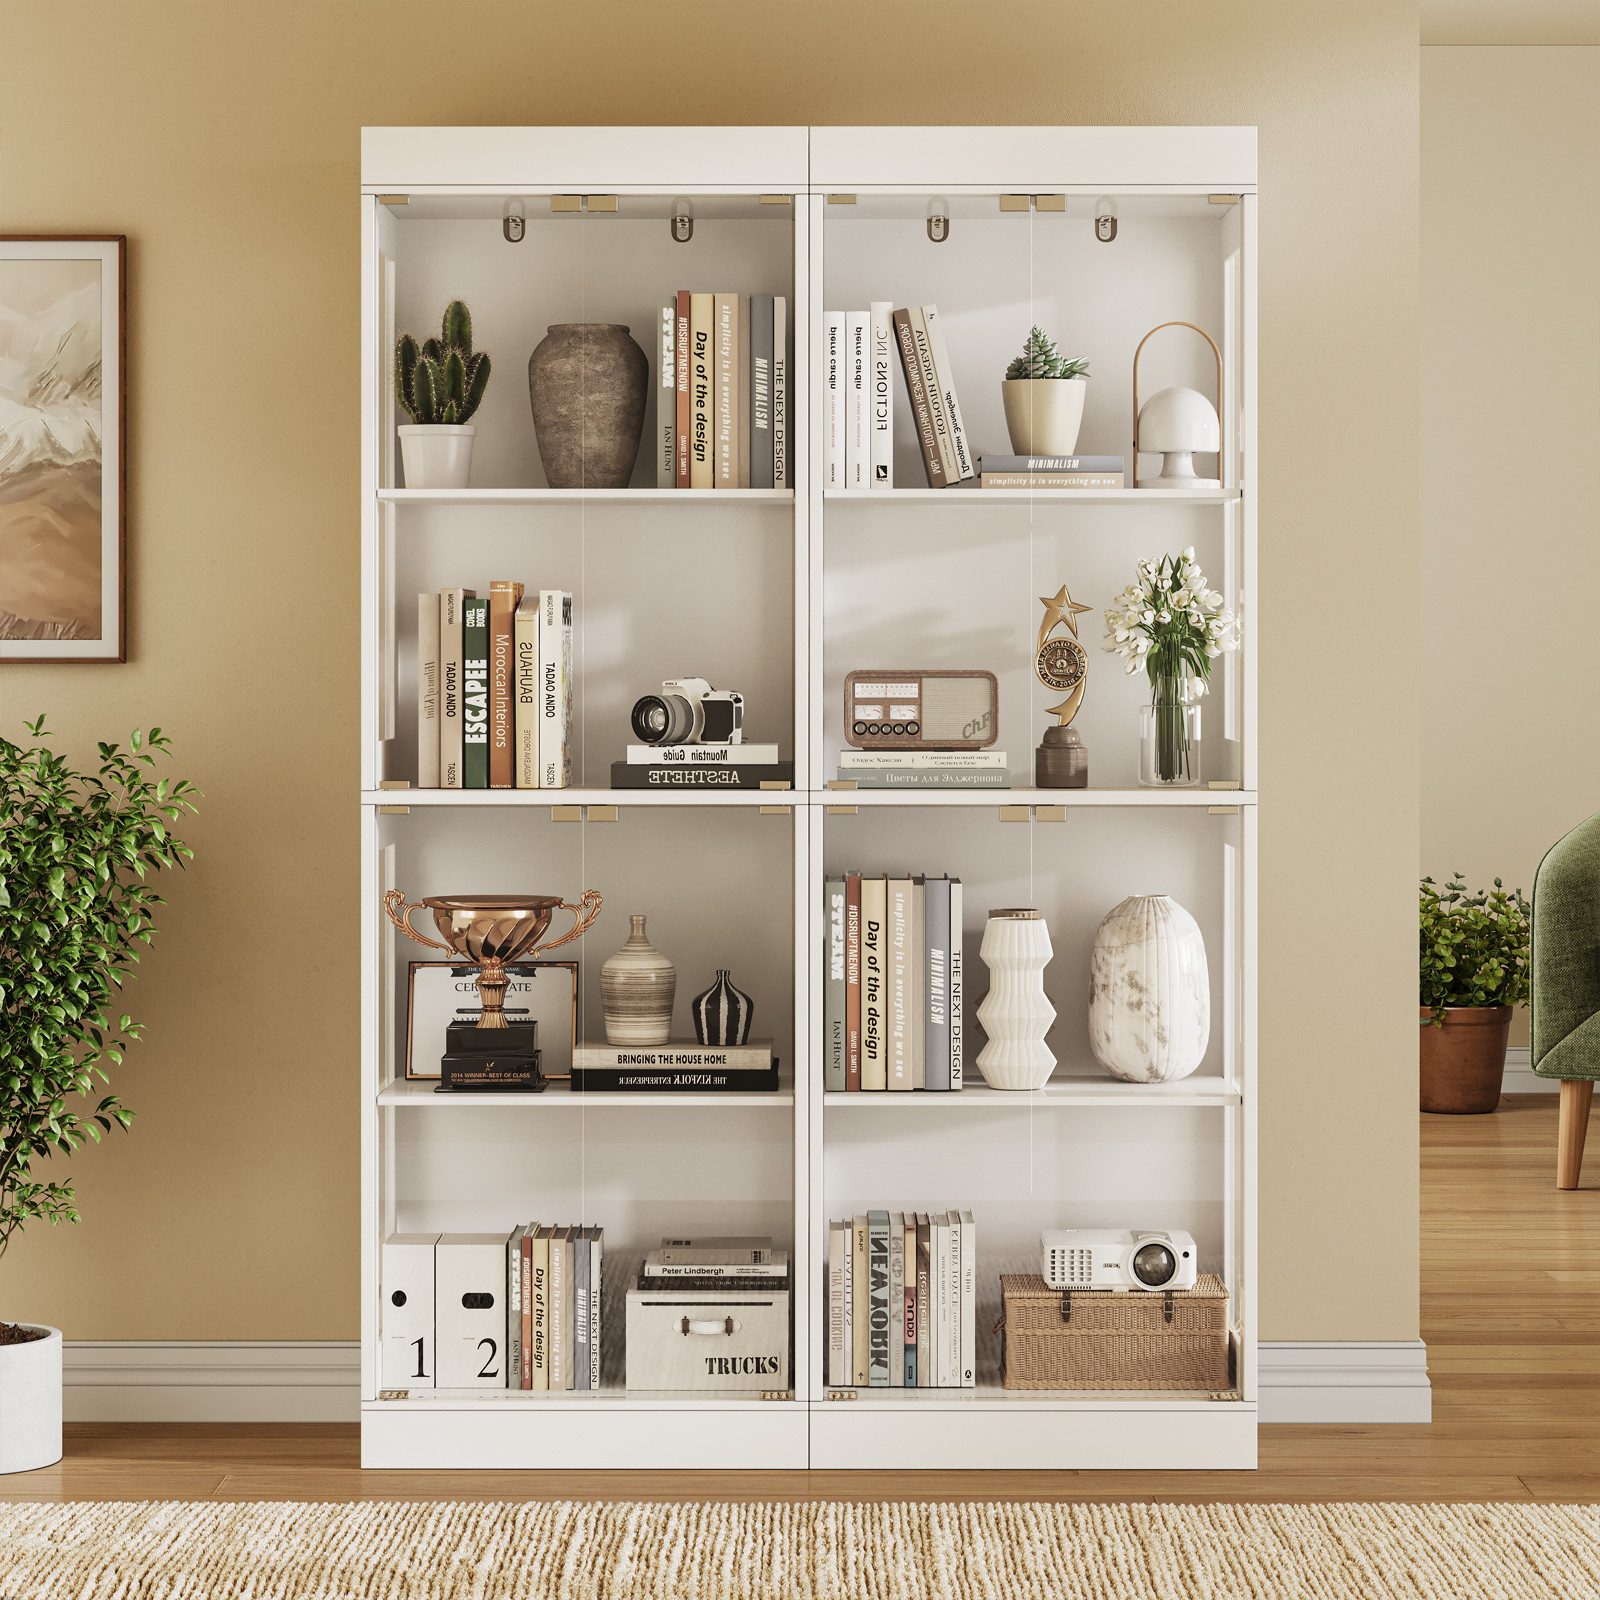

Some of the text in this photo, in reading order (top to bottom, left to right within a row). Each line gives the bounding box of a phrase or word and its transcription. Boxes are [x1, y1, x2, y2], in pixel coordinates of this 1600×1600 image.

[662, 307, 675, 389] STEAM
[720, 304, 730, 357] simplicity
[678, 317, 688, 392] #DISRUPTMENOW
[722, 360, 730, 369] is
[722, 374, 730, 382] in
[693, 331, 708, 462] Day of the design
[720, 386, 730, 441] everything
[755, 357, 768, 429] MINIMALISM
[775, 359, 784, 481] THE NEXT DESIGN
[664, 445, 673, 472] HUNT
[722, 444, 729, 460] we
[1027, 459, 1080, 469] MINIMALISM
[989, 477, 1027, 486] simplicity
[1048, 477, 1088, 486] everything
[446, 662, 456, 718] TADAO ANDO
[465, 659, 487, 743] ESCAPEE
[496, 634, 509, 748] Moroccan Interiors
[545, 662, 556, 718] TADAO ANDO
[886, 773, 918, 784] Цветы
[921, 775, 940, 783] для
[942, 773, 1003, 784] Элджернона
[831, 894, 844, 981] STEAM
[848, 905, 858, 985] #DISRUPTMENOW
[454, 982, 532, 992] CERATE
[864, 920, 880, 1060] Day of the design
[893, 892, 904, 1078] simplicity is in everything we see
[930, 948, 944, 1025] MINIMALISM
[952, 950, 961, 1080] THE NEXT DESIGN
[617, 1054, 727, 1065] BRINGING THE HOUSE HOME
[833, 1041, 842, 1070] HUNT
[850, 1030, 858, 1048] DAVID
[850, 1054, 858, 1074] SMITH
[552, 1248, 560, 1287] simplicity
[661, 1267, 724, 1276] Peter Lindbergh
[533, 1268, 544, 1369] Day of the design
[552, 1309, 560, 1350] everything
[577, 1288, 587, 1344] MINIMALISM
[410, 1336, 430, 1378] 1
[477, 1337, 500, 1378] 2
[554, 1353, 560, 1366] we
[705, 1356, 779, 1375] TRUCKS
